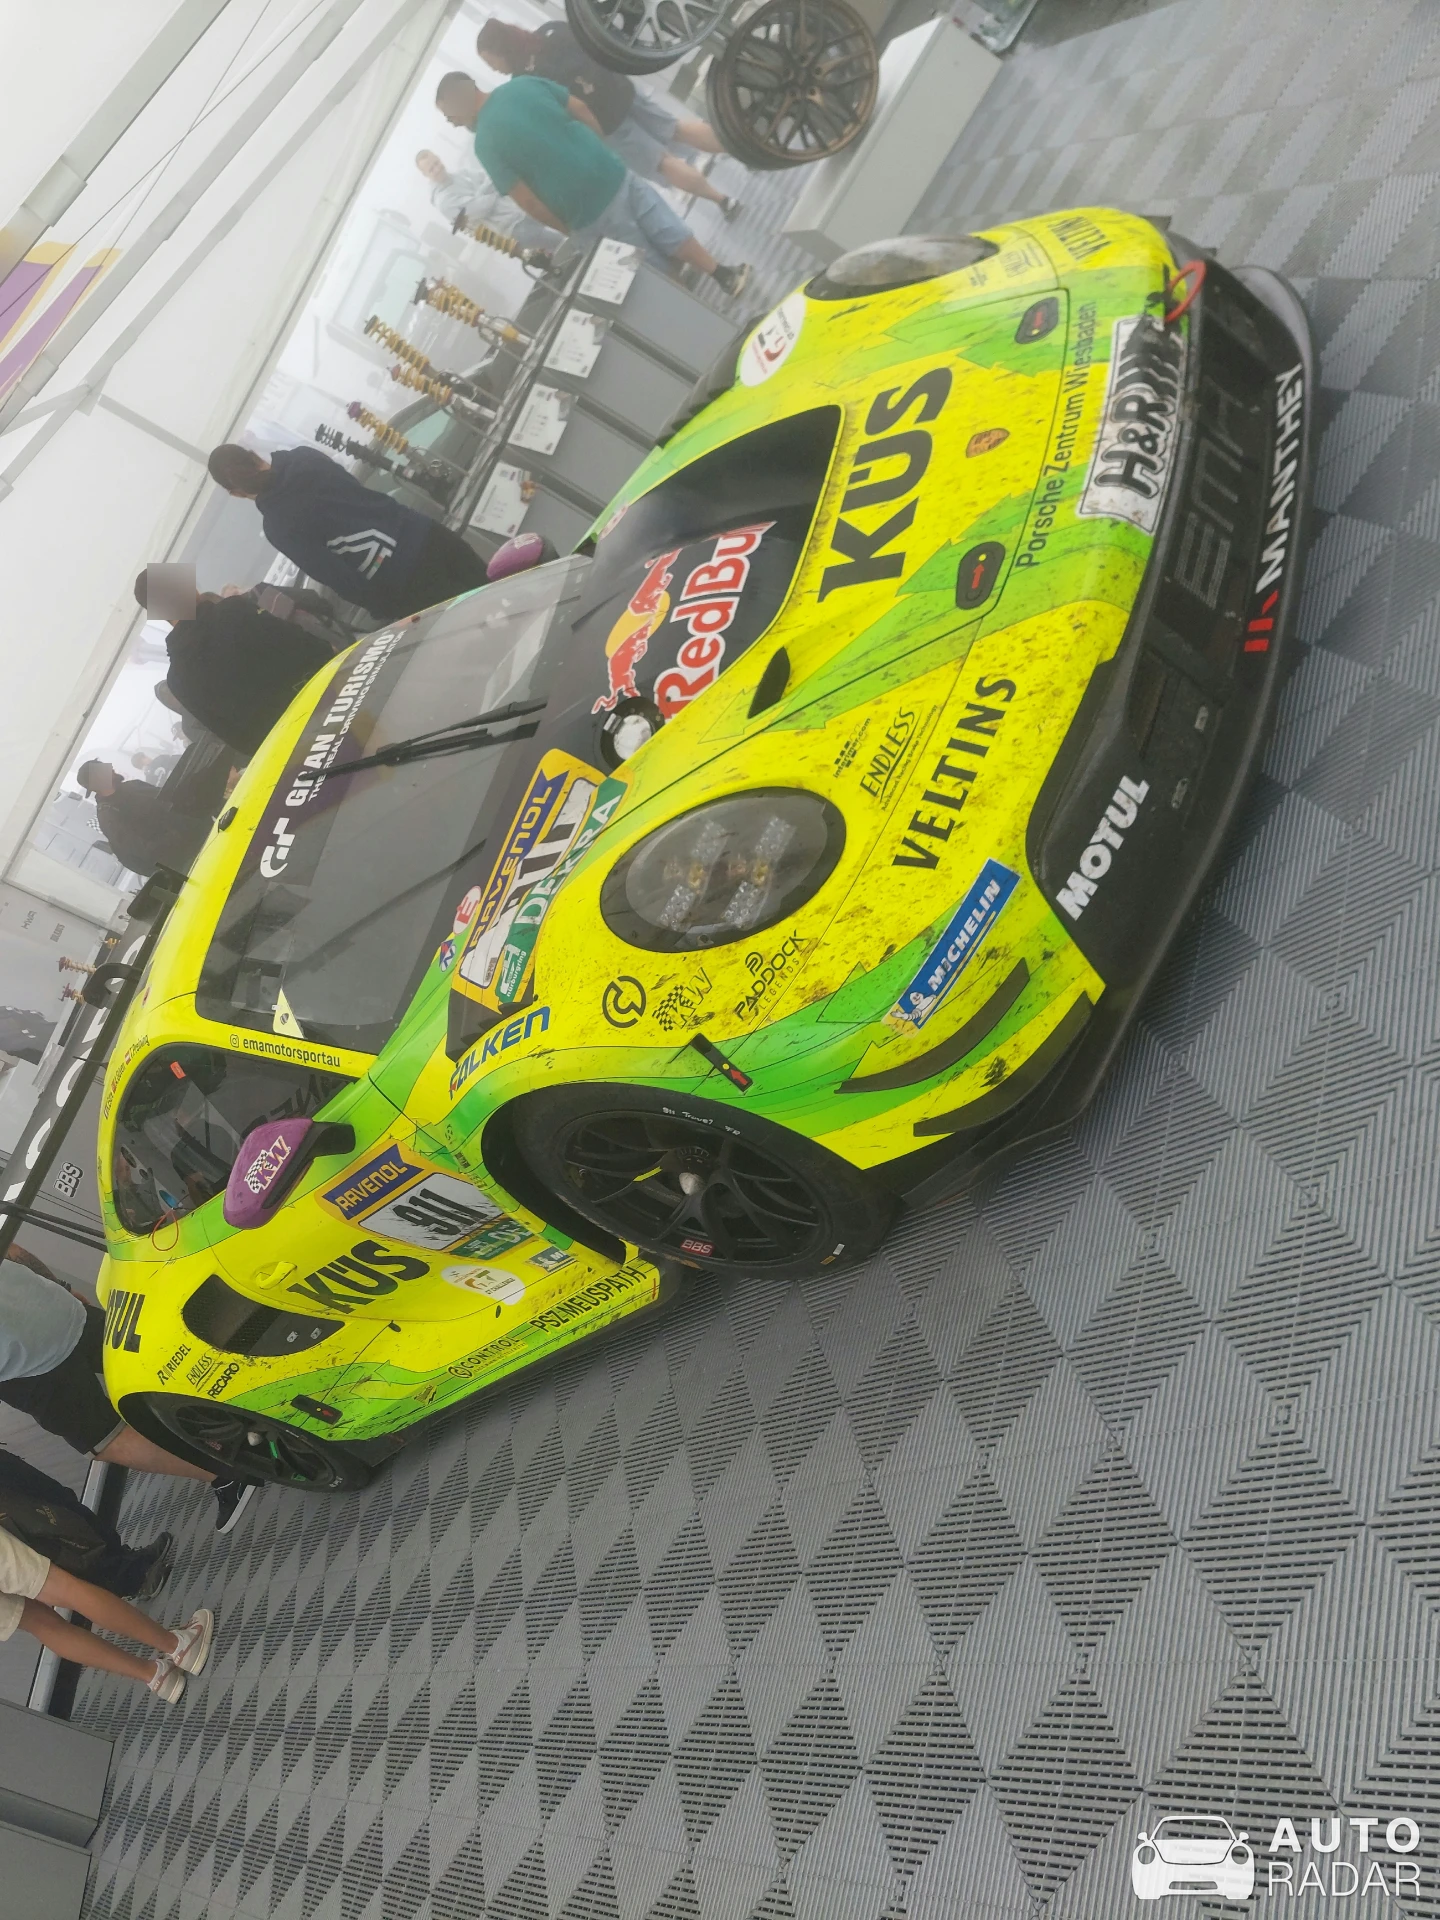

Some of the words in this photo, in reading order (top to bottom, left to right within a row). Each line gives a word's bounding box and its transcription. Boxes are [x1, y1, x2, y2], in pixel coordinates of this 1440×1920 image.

[1064, 302, 1097, 391] Wiesbaden
[1043, 390, 1086, 479] Zentrum
[1095, 384, 1176, 499] H&R
[1256, 362, 1302, 594] MANTHEY
[817, 367, 953, 603] KÜS
[1015, 478, 1065, 568] Porsche
[323, 629, 396, 727] TURISMO
[654, 597, 740, 723] Red
[308, 775, 326, 802] THE
[340, 686, 371, 735] DRIVING
[368, 629, 408, 686] SIMULATOR
[833, 717, 871, 779] interimer.com
[860, 706, 915, 797] ENDLESS
[892, 673, 1017, 870] VELTINS
[470, 786, 553, 948] RAVENOL
[514, 794, 622, 926] DEKRA
[1055, 774, 1150, 921] MOTUL
[506, 950, 527, 997] nürburgring
[734, 929, 808, 1020] PADDOCK
[927, 879, 1001, 992] MICHELIN
[759, 957, 800, 1010] LEGENDS
[242, 1036, 341, 1068] emamotorsportau
[448, 1006, 551, 1101] FALKEN
[53, 1160, 84, 1198] BBS
[335, 1160, 408, 1212] RAVENOL
[392, 1188, 488, 1236] 911
[286, 1239, 431, 1315] KÜS
[493, 1276, 516, 1292] CHALLENGE
[681, 1239, 713, 1254] BBS
[530, 1308, 570, 1334] PSZ
[562, 1265, 647, 1320] MEUSPATH
[166, 1343, 192, 1373] RIEDEL
[186, 1353, 214, 1386] ENDLESS
[207, 1361, 240, 1399] RECARO
[460, 1335, 522, 1371] CONTROL
